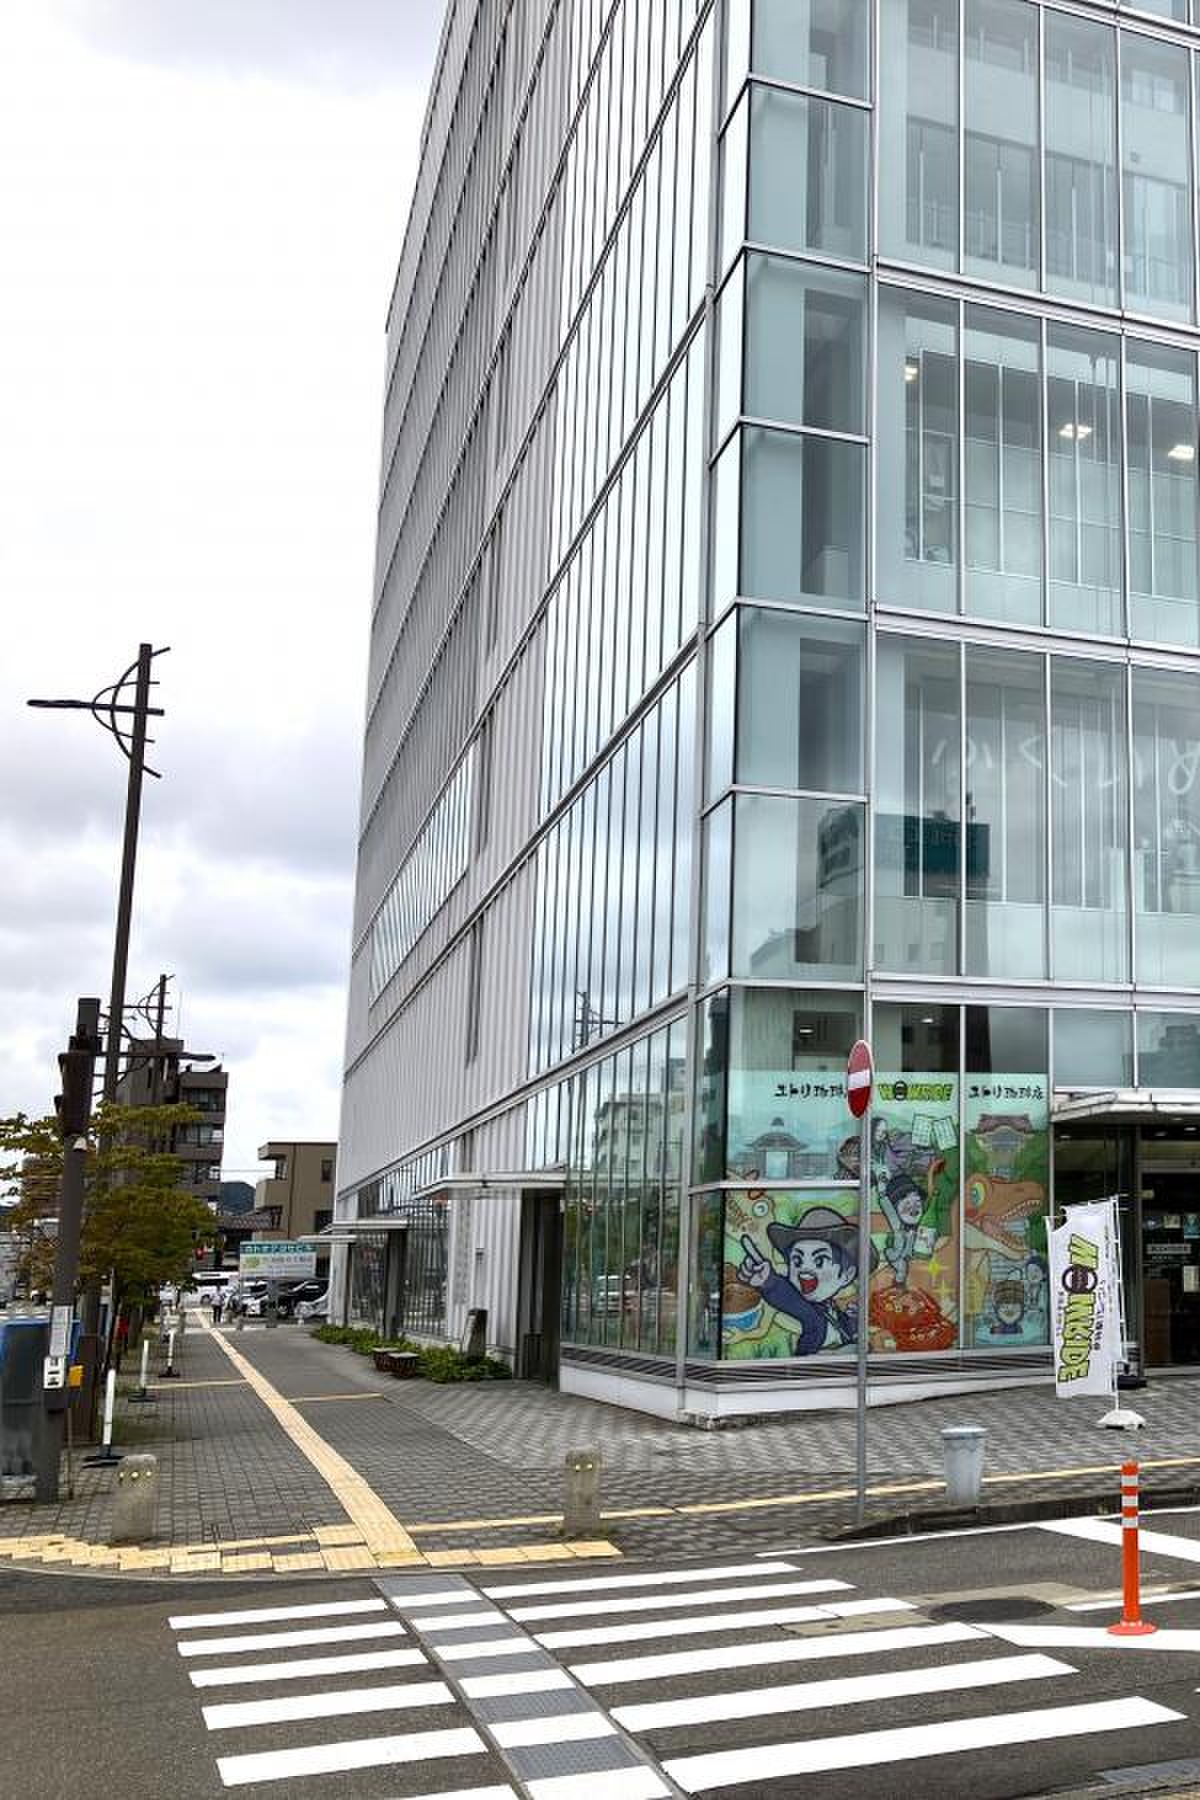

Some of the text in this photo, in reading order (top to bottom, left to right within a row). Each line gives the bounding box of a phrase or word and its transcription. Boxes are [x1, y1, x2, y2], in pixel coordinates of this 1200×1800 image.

[774, 1083, 848, 1099] ユトリ珈琲
